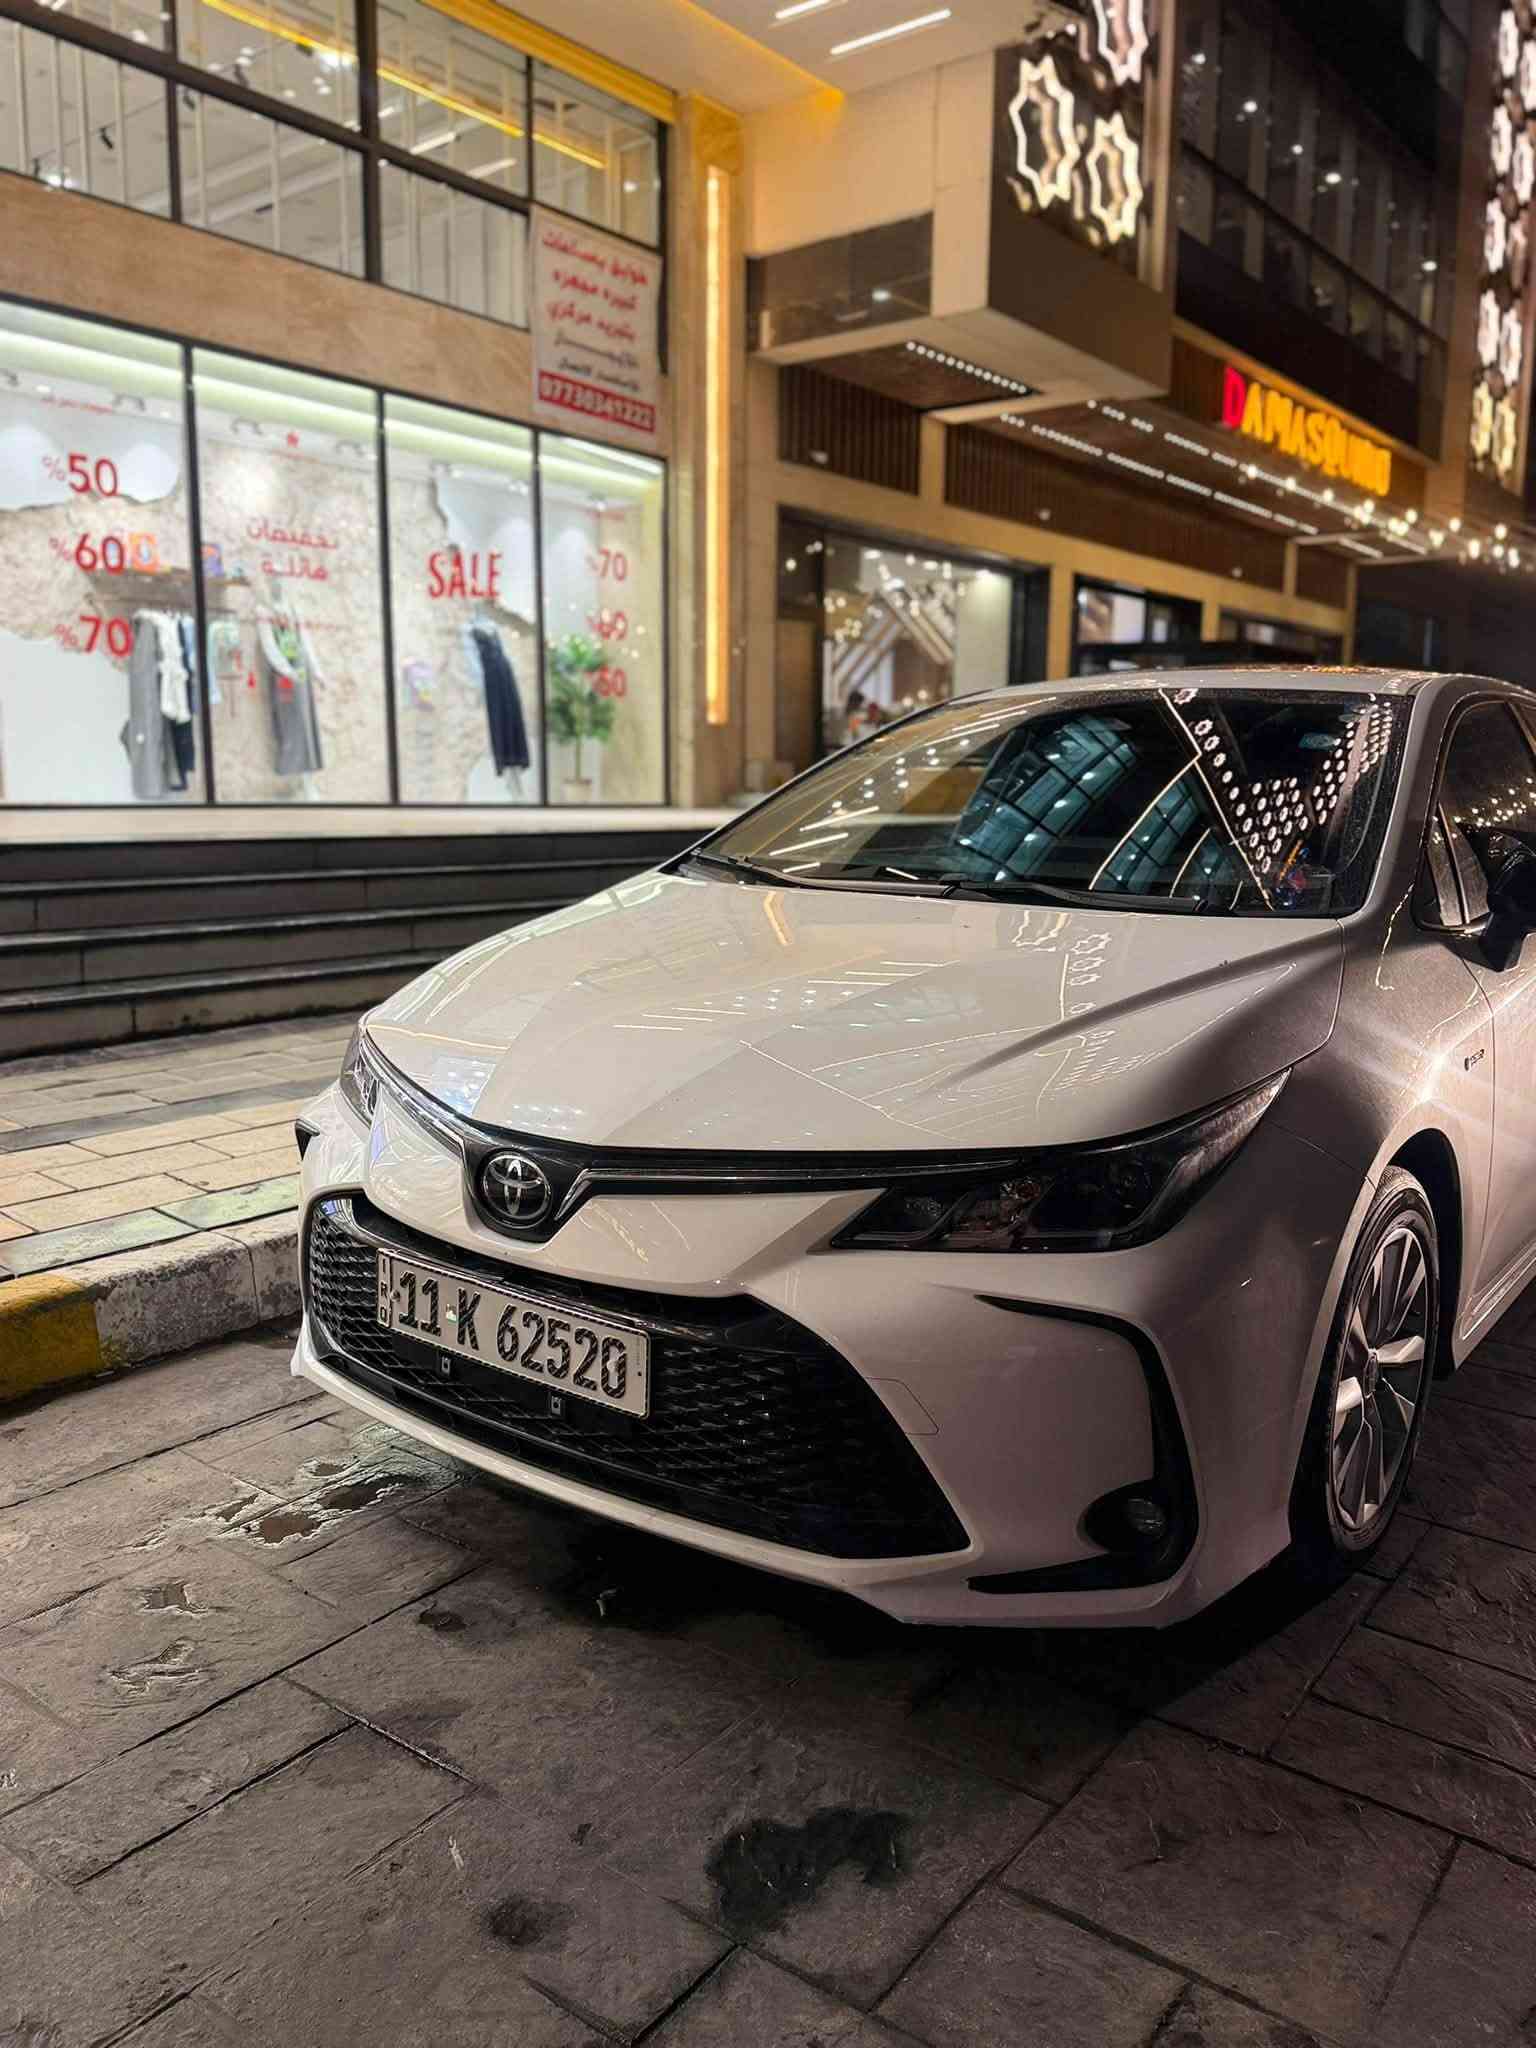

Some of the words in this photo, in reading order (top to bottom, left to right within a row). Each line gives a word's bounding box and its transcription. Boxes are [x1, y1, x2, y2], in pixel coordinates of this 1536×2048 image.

[428, 552, 502, 598] SALE
[399, 1270, 441, 1337] 11
[456, 1287, 481, 1351] K
[496, 1303, 627, 1399] 62520
